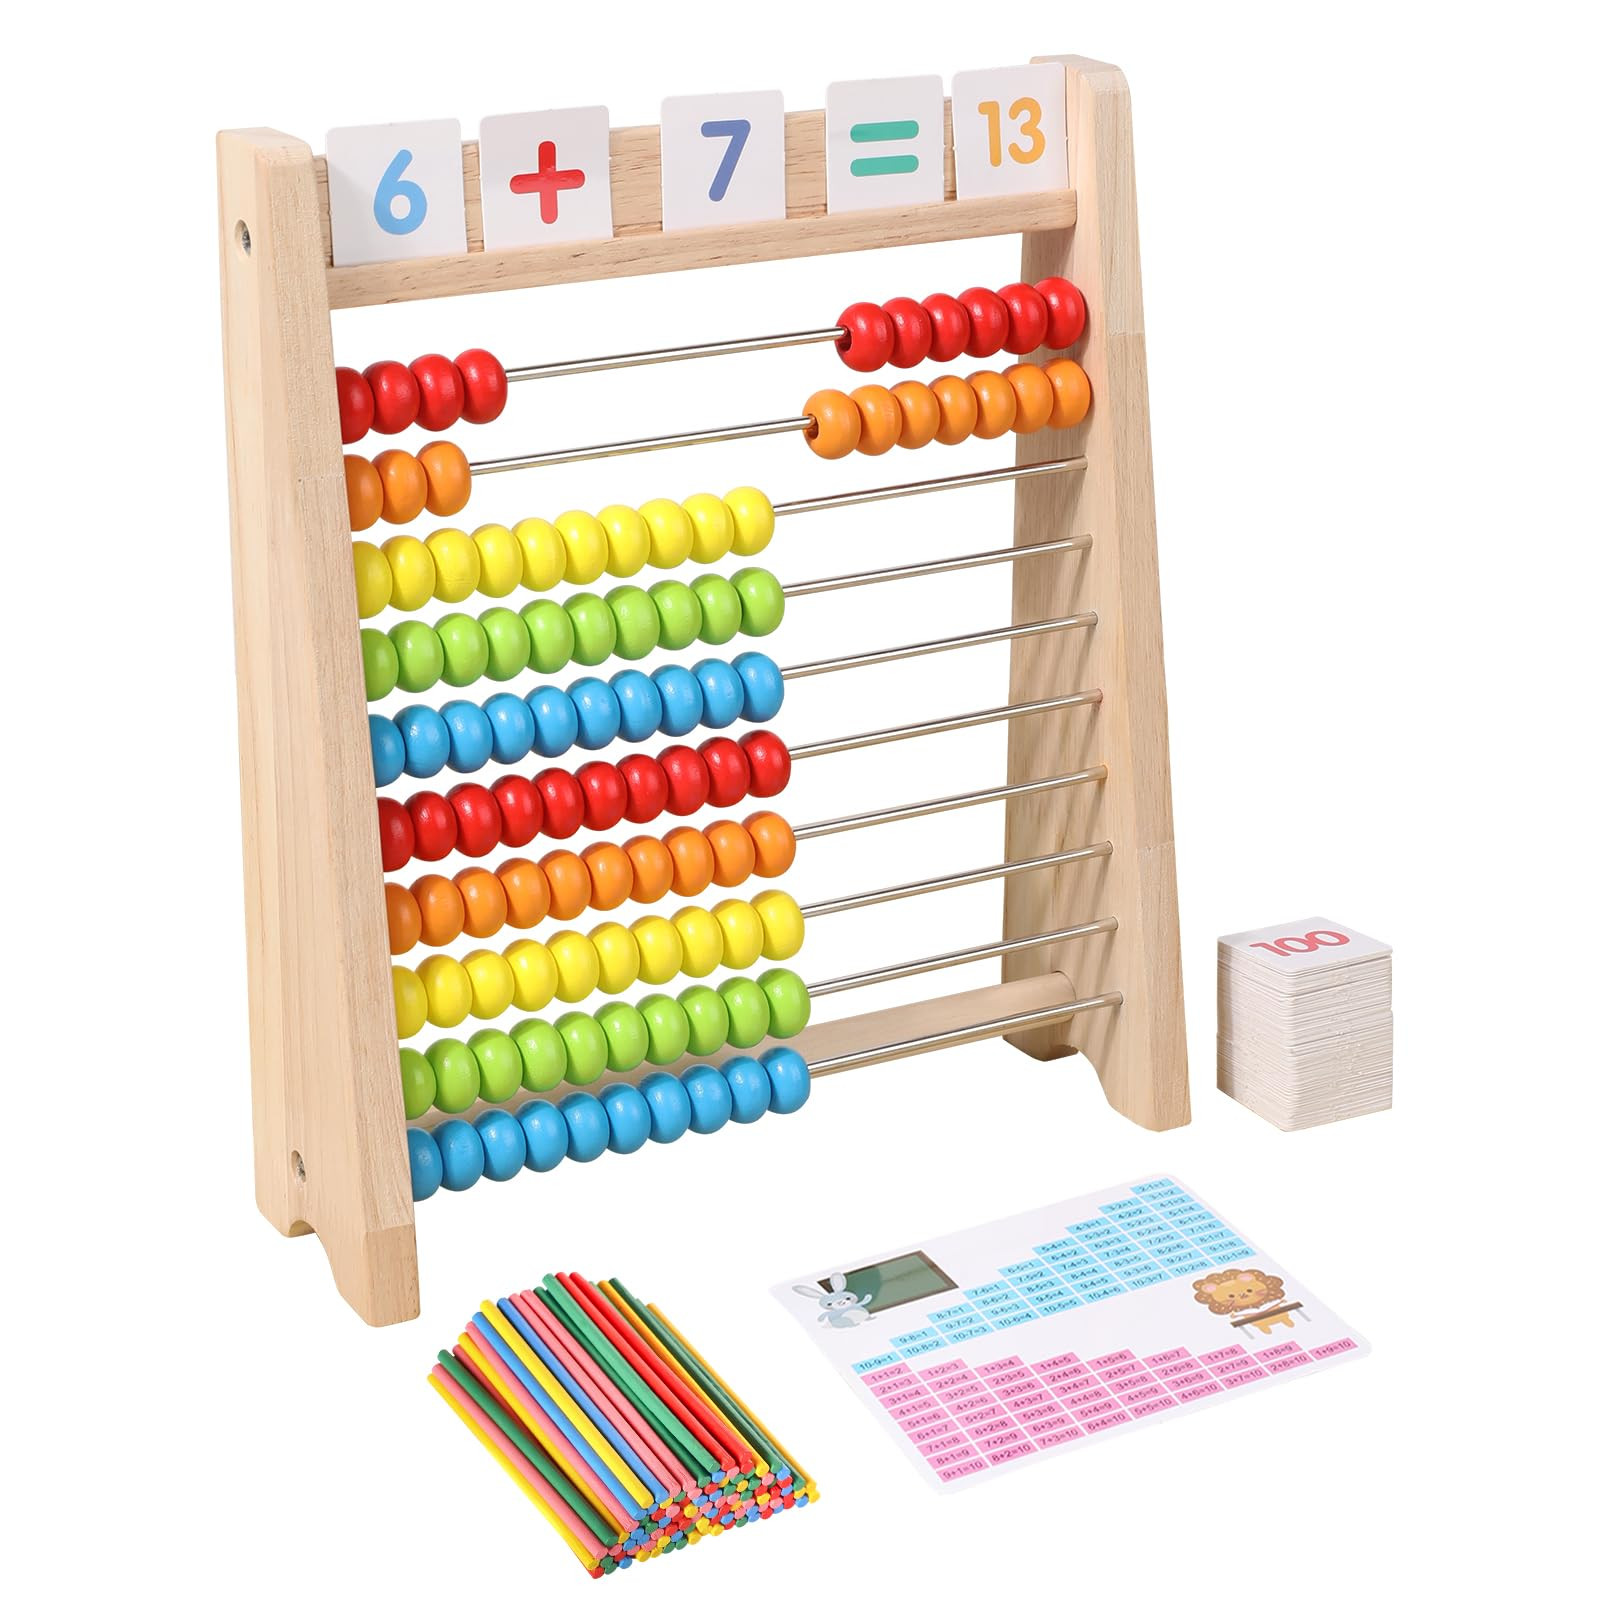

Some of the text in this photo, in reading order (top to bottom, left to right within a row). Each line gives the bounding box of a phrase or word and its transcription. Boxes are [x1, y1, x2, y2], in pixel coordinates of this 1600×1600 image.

[374, 97, 1046, 234] 6 + 7 = 13
[1249, 930, 1350, 957] 100
[871, 1367, 904, 1382] 1+1=2
[879, 1362, 959, 1395] 2+1=3 1+2=3
[888, 1359, 1015, 1405] 3+1=4 2+2=4 1+3=4
[898, 1356, 1072, 1416] 4+1=5 3+2=5 2+3=5 1+4=5
[907, 1353, 1127, 1427] 5+1=6 4+2=6 3+3=6 2+4=6 1+5=6
[916, 1350, 1181, 1440] 6+1=7 5+2=7 4+3=7 3+4=7 2+5=7 1+6=7
[927, 1348, 1238, 1452] 7+1=8 6+2=8 5+3=8 4+4=8 3+5=8 2+6=8 1+7=8
[936, 1345, 1293, 1465] 8+1=9 7+2=9 6+3=9 5+4=9 4+5=9 3+6=9 2+7=9 1+8=9
[942, 1341, 1351, 1480] 9+1=10 8+2=10 7+3=10 6+4=10 5+5=10 4+6=10 3+7=10 2+8=10 1+9=10
